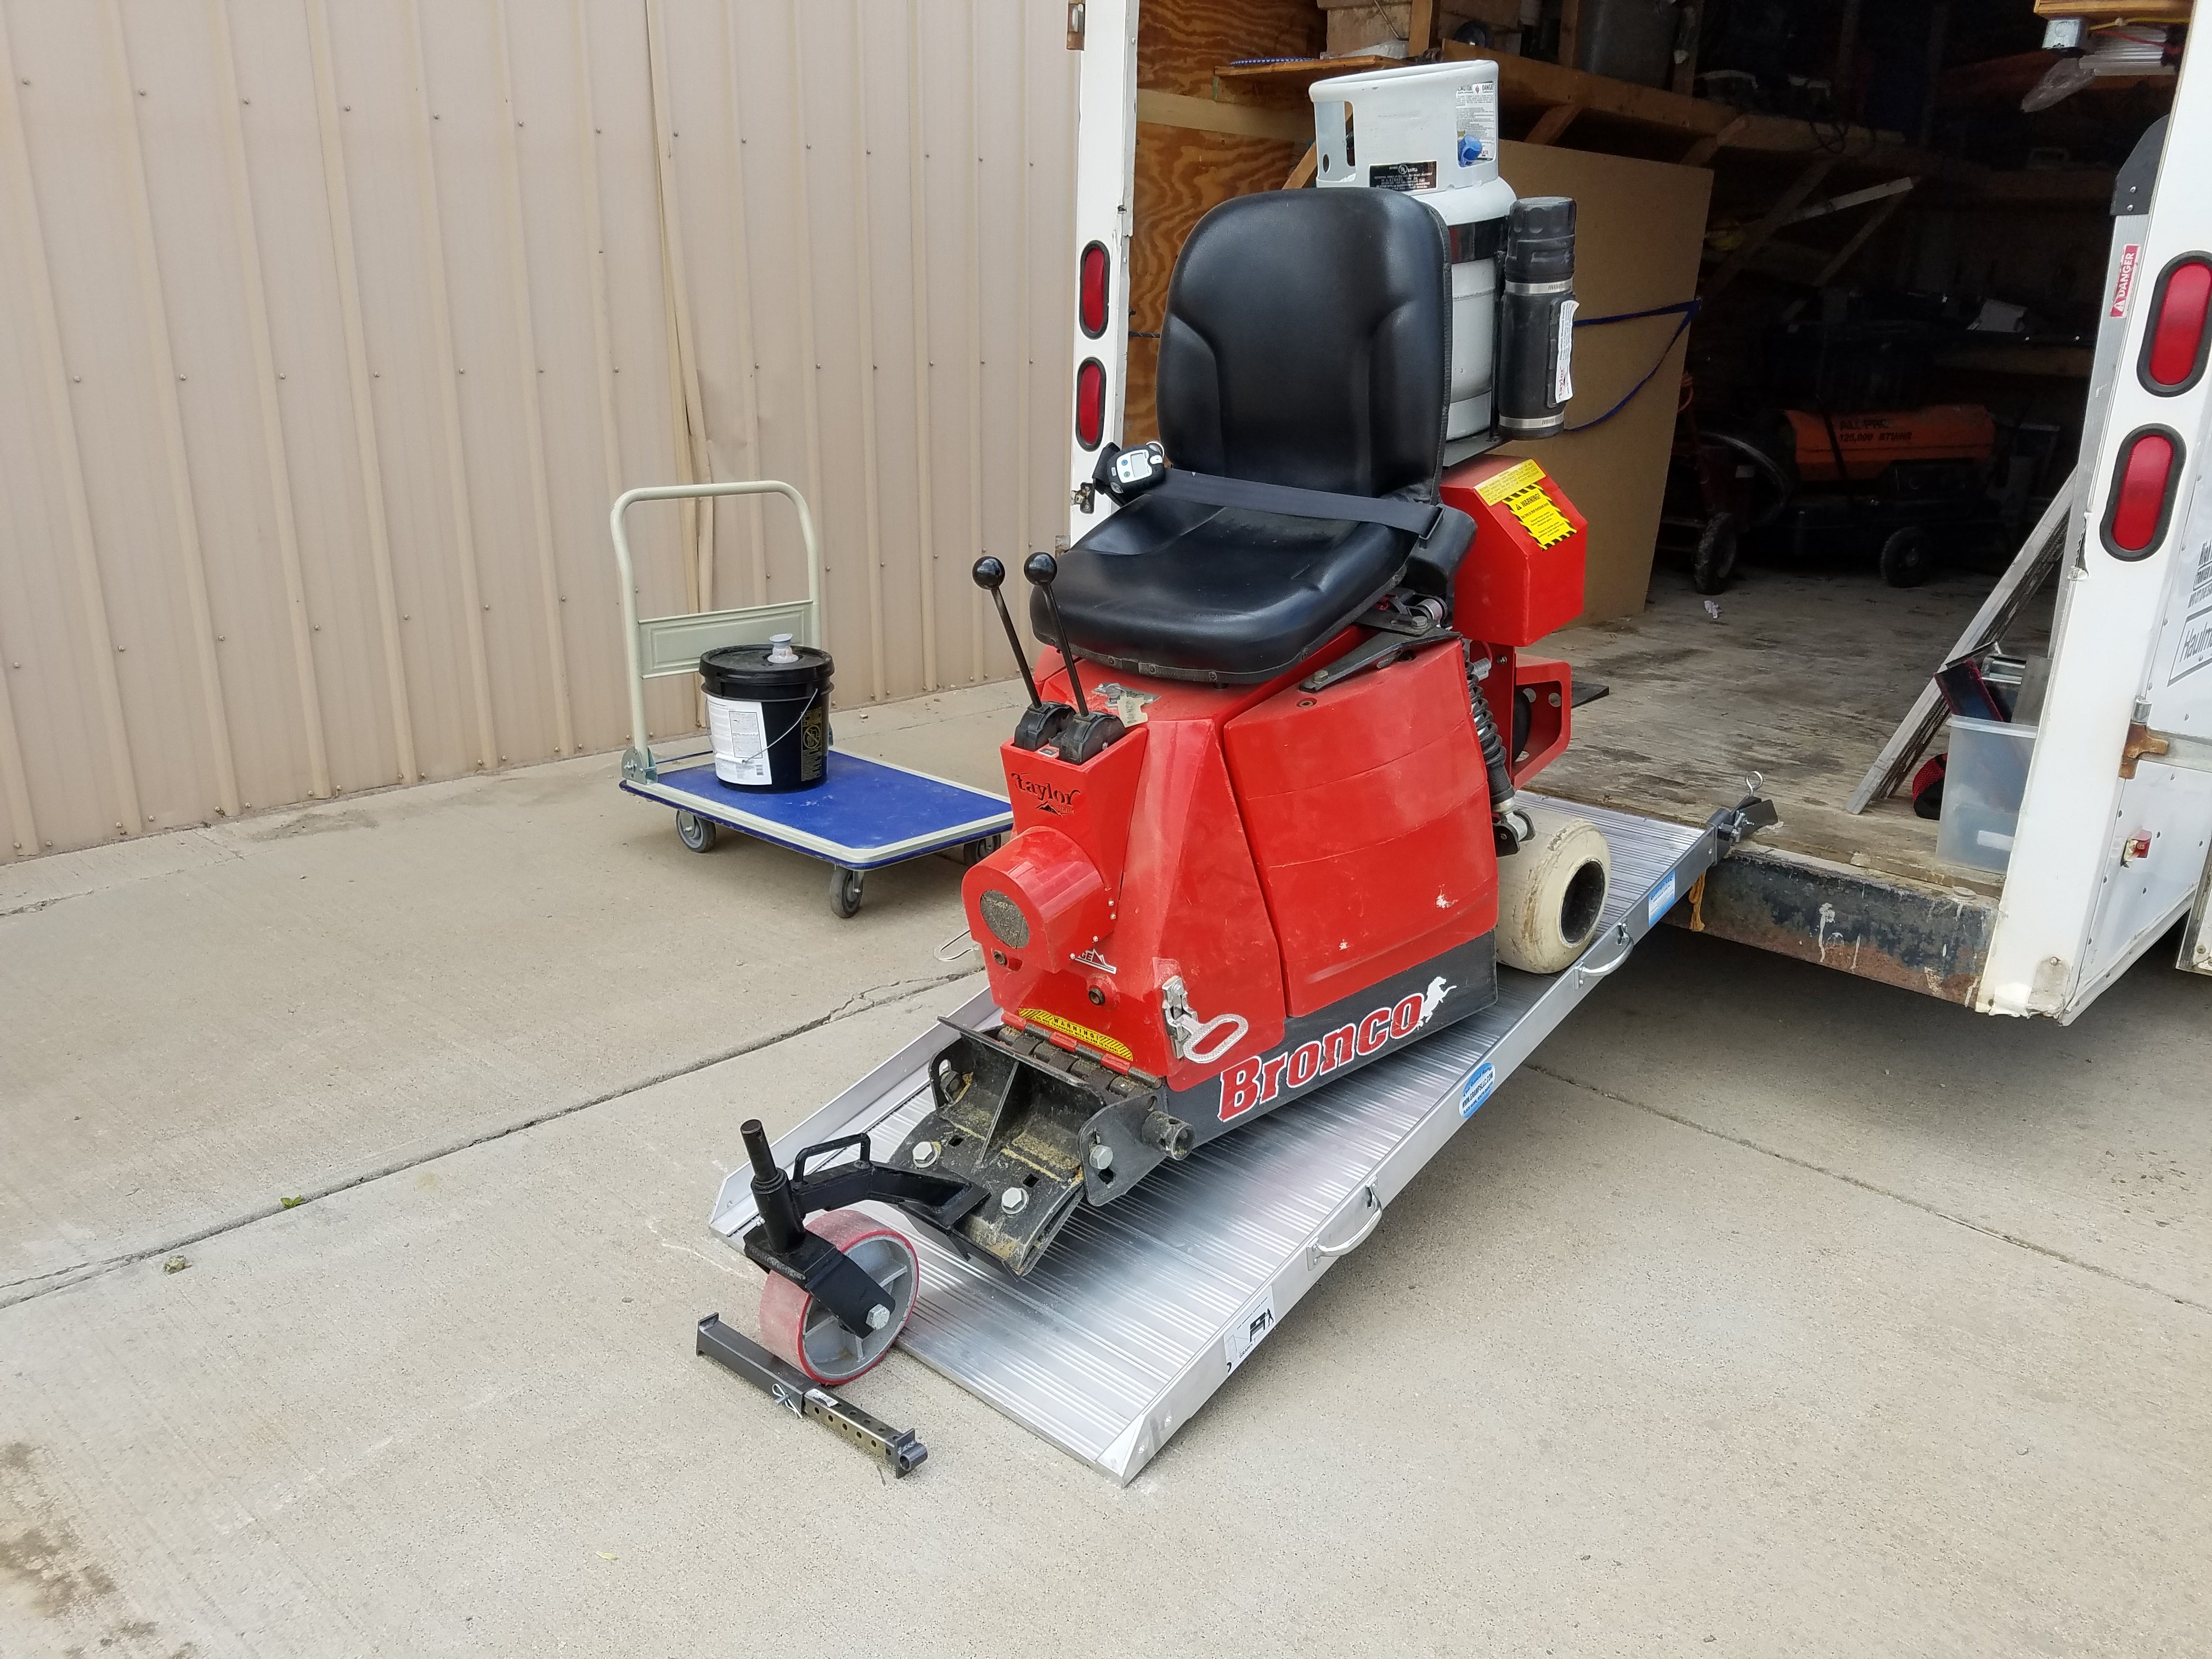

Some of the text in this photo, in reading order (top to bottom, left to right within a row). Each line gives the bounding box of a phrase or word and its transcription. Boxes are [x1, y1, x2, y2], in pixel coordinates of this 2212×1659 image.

[2119, 253, 2135, 297] DANGER
[1520, 493, 1541, 507] WARNING!
[2179, 622, 2212, 662] Haulm
[1054, 1017, 1098, 1040] WARNING!
[1217, 992, 1425, 1122] Bronco
